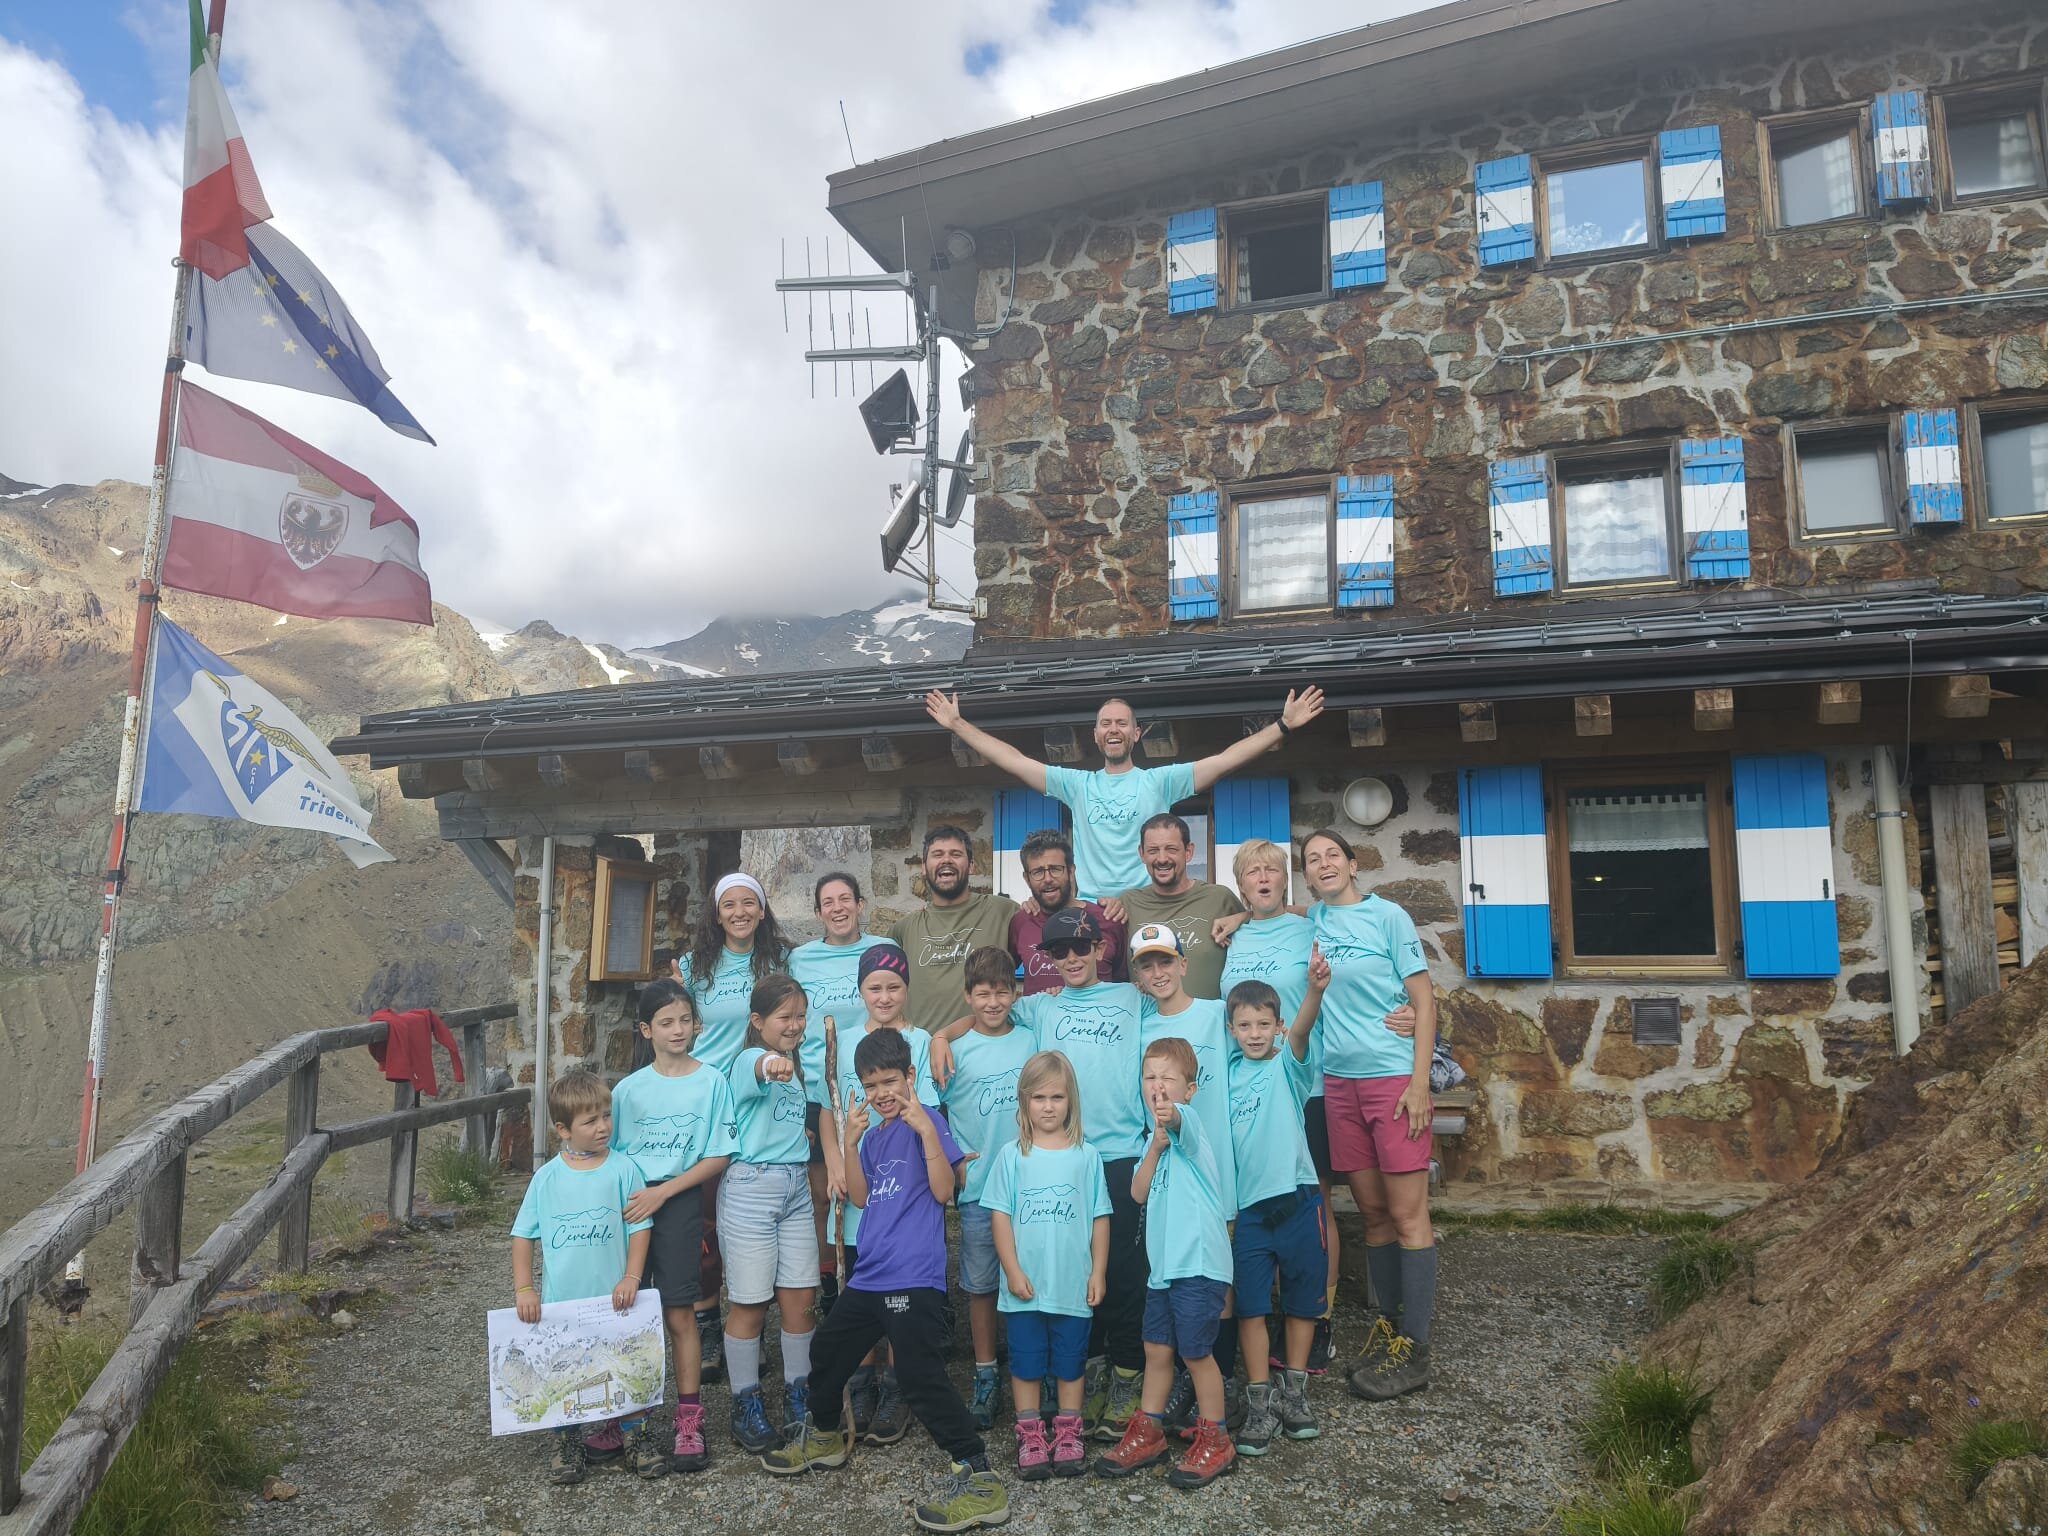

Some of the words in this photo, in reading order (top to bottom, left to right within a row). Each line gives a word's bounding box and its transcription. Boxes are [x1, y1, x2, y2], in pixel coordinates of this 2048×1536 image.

[300, 795, 365, 833] Triden
[1056, 1015, 1124, 1043] Cevedale
[1020, 1199, 1077, 1224] Cevedale
[552, 1224, 615, 1249] Cevedale
